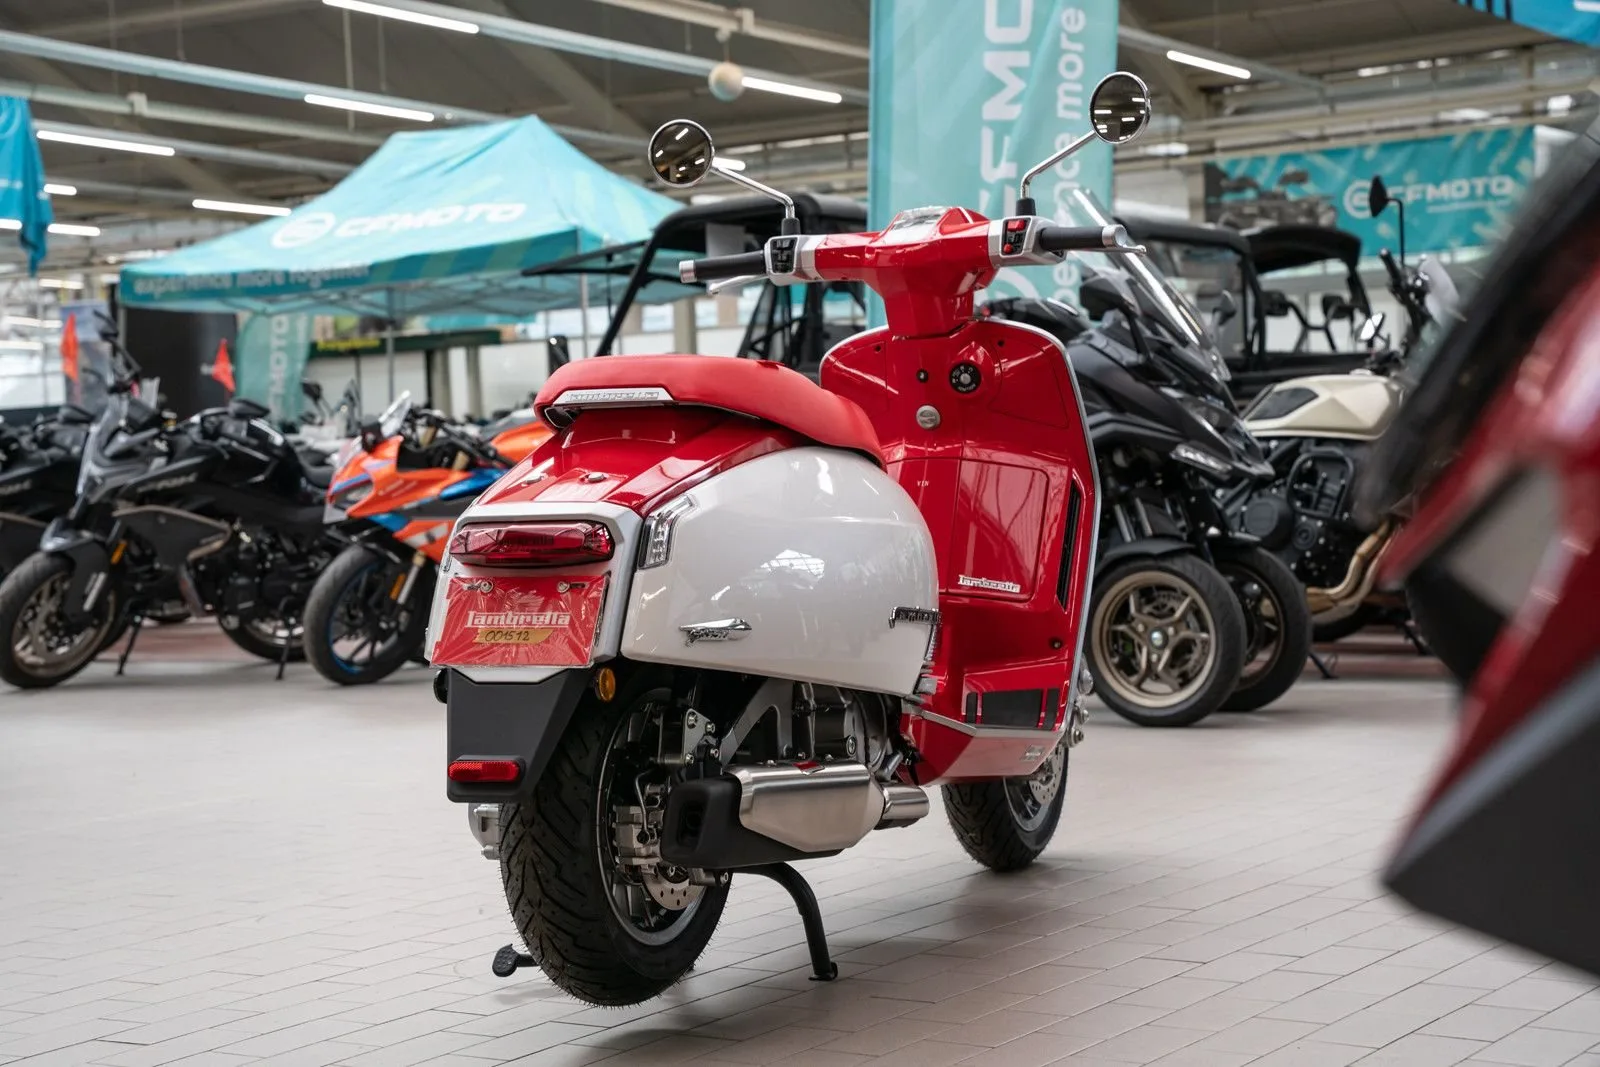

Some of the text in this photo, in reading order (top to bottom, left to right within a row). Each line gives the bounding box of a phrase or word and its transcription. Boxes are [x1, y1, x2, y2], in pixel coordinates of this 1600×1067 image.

[1056, 7, 1087, 120] more
[334, 203, 528, 238] CFMOTO
[484, 630, 530, 642] 001512
